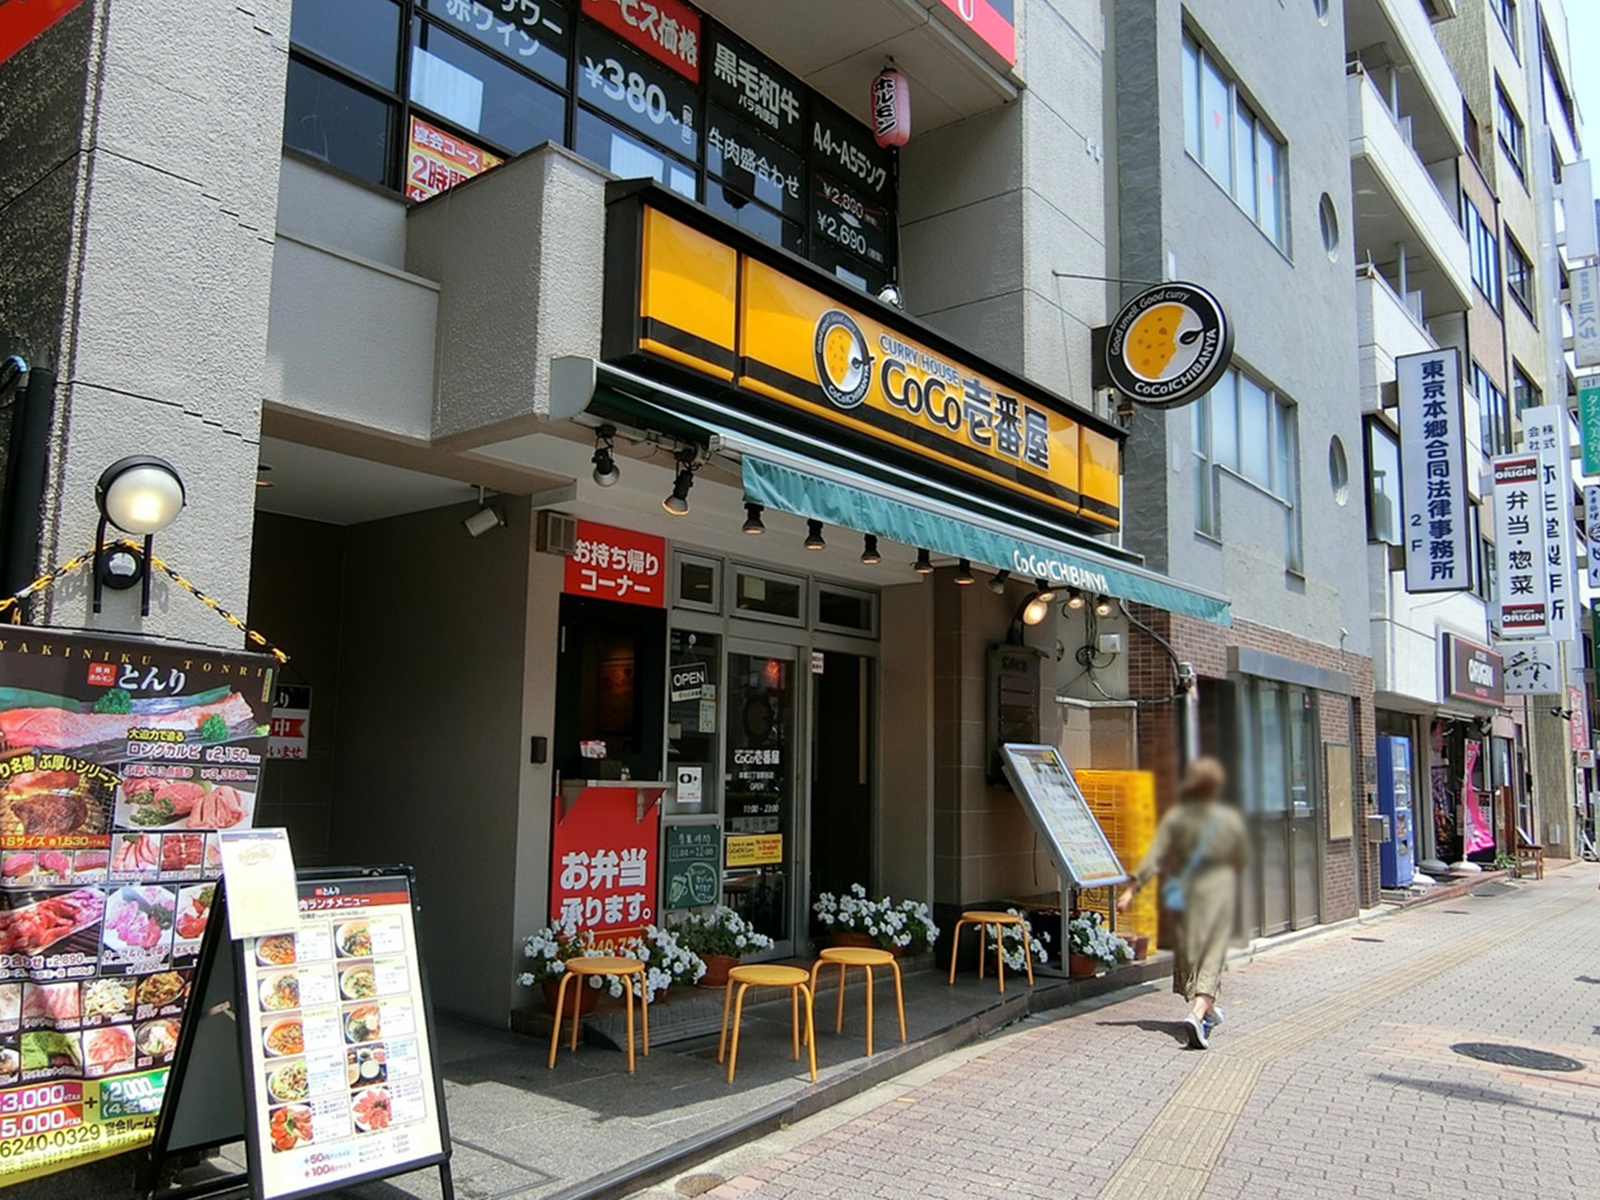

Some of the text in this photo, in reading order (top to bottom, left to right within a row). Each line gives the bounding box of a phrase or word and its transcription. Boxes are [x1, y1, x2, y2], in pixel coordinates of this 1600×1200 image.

[713, 42, 800, 124] 黒毛和牛
[875, 77, 897, 137] ホルモン
[708, 126, 800, 199] 牛肉盛合わせ
[817, 210, 866, 255] ¥2,690
[880, 334, 960, 388] CURRY HOUSE
[1134, 328, 1217, 395] CoCoICHIBANYA
[1421, 359, 1455, 581] 東京本郷合同法律事務所
[1495, 468, 1537, 480] ORIGIN
[573, 538, 659, 576] お持ち帰り
[1506, 490, 1534, 595] 弁当・惣菜
[580, 568, 651, 597] コーナー
[1502, 612, 1545, 623] ORIGIN
[118, 663, 186, 695] とんり
[183, 659, 263, 678] TONRI
[673, 671, 705, 687] OPEN
[128, 743, 202, 759] ロングカルビ
[560, 848, 647, 890] お弁当
[560, 892, 651, 927] 承ります。
